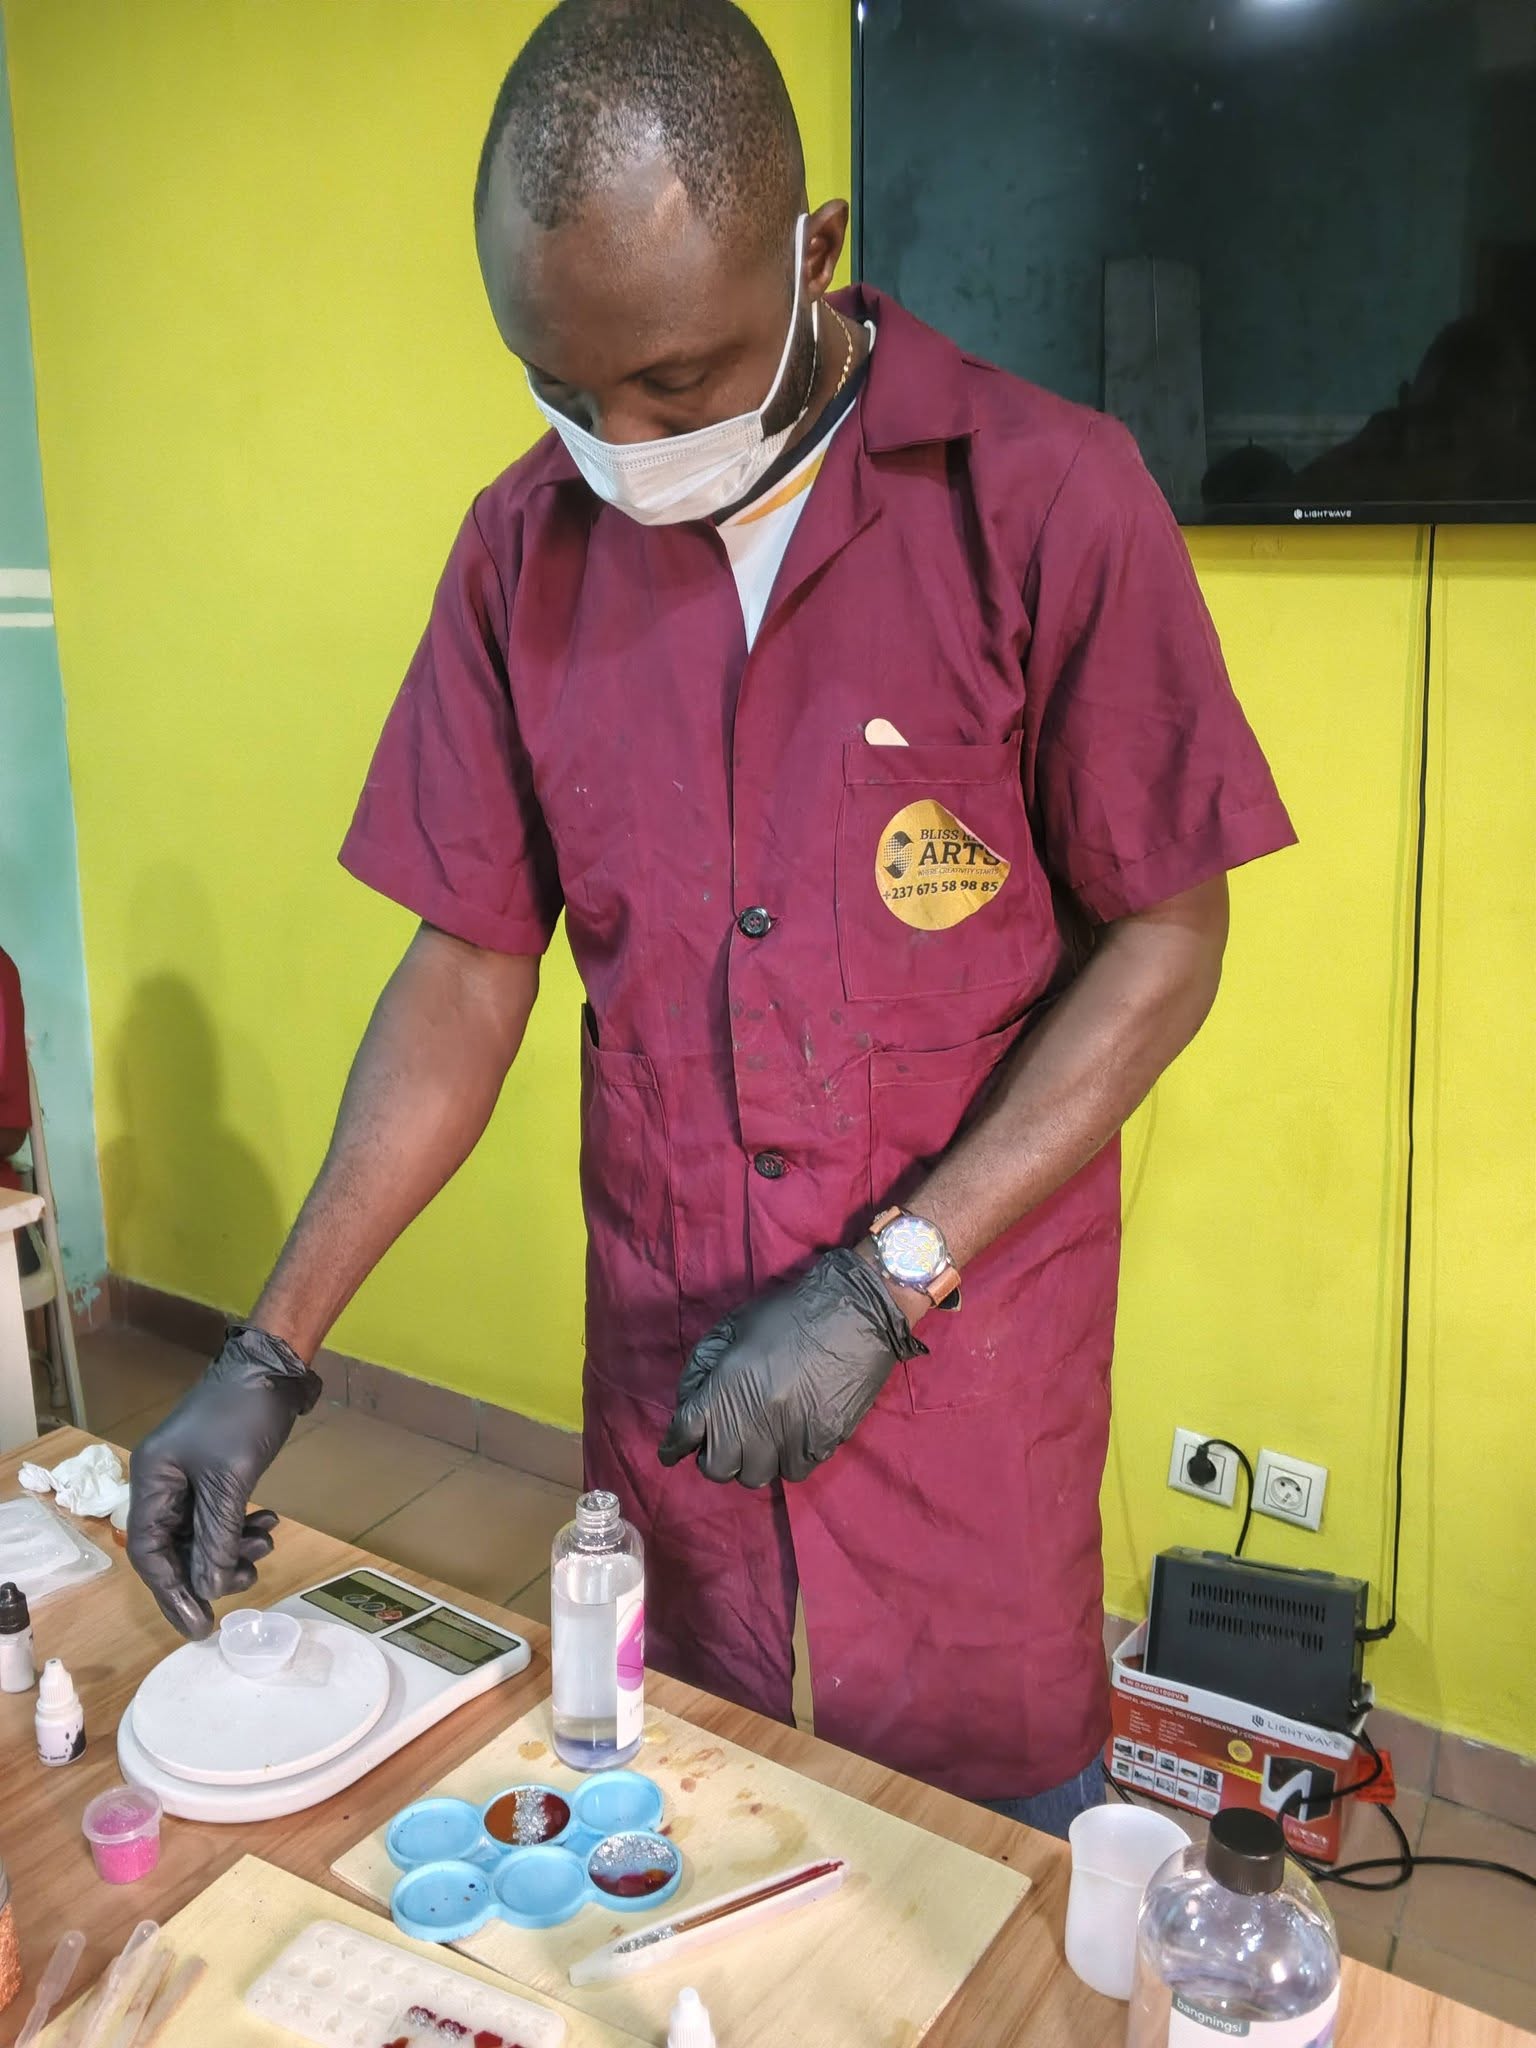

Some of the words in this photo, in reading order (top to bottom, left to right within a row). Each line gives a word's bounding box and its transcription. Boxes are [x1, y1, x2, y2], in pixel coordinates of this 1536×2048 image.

[1304, 510, 1352, 518] LIGHTWAVE
[920, 829, 959, 840] BLISS
[918, 841, 1000, 866] ARTS
[883, 885, 913, 900] +237
[916, 882, 938, 896] 675
[941, 880, 957, 893] 58
[960, 880, 977, 891] 98
[981, 881, 998, 893] 85
[1177, 1998, 1242, 2034] bangningsi
